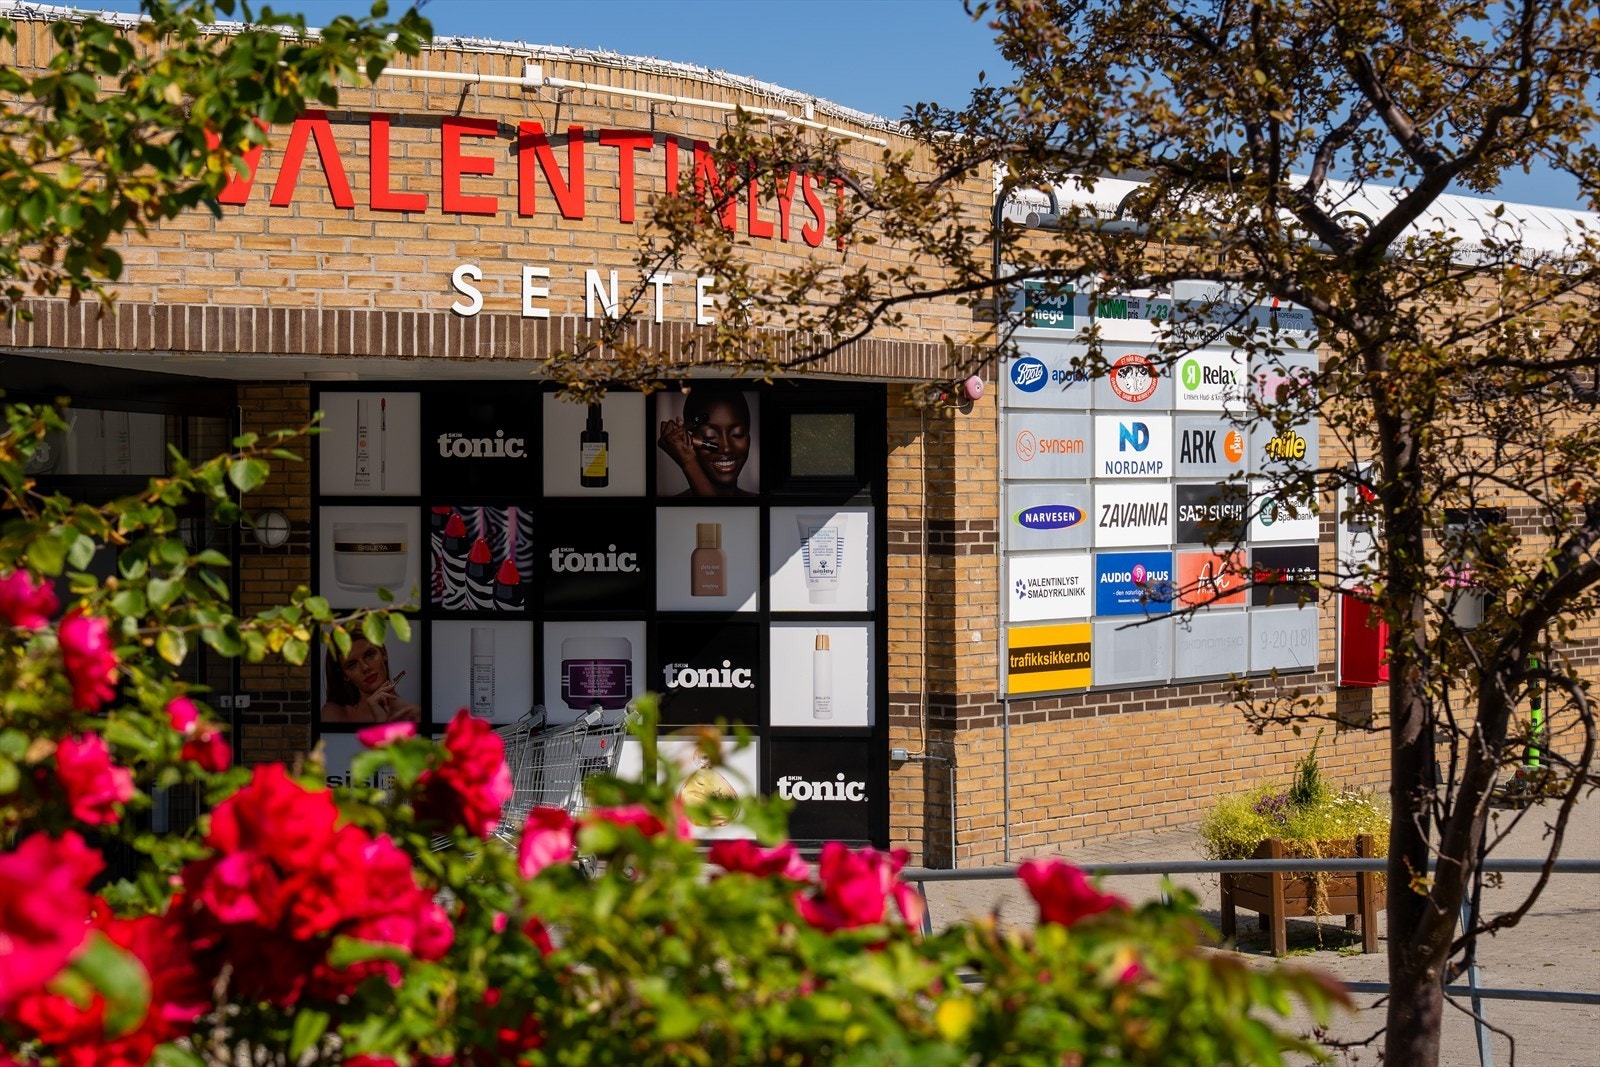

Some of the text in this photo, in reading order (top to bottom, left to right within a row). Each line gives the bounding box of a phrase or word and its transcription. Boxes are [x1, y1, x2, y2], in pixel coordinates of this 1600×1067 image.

[450, 264, 750, 326] SENTE
[1127, 299, 1140, 309] mini
[1098, 299, 1127, 320] KIWI
[1127, 310, 1139, 321] pris
[1014, 363, 1043, 386] Boots
[1203, 365, 1238, 385] Relax
[1119, 422, 1150, 452] ND
[1039, 439, 1084, 454] SYNSAM
[1179, 429, 1217, 464] ARK
[1105, 460, 1164, 475] NORDAMP
[1025, 511, 1076, 523] NARVESEN
[1099, 501, 1169, 529] ZAVANNA
[1209, 504, 1243, 522] SUSHI
[1027, 576, 1080, 588] VALENTINLYST
[1100, 570, 1169, 584] AUDIO PLUS
[1009, 650, 1091, 668] trafikksikker.no
